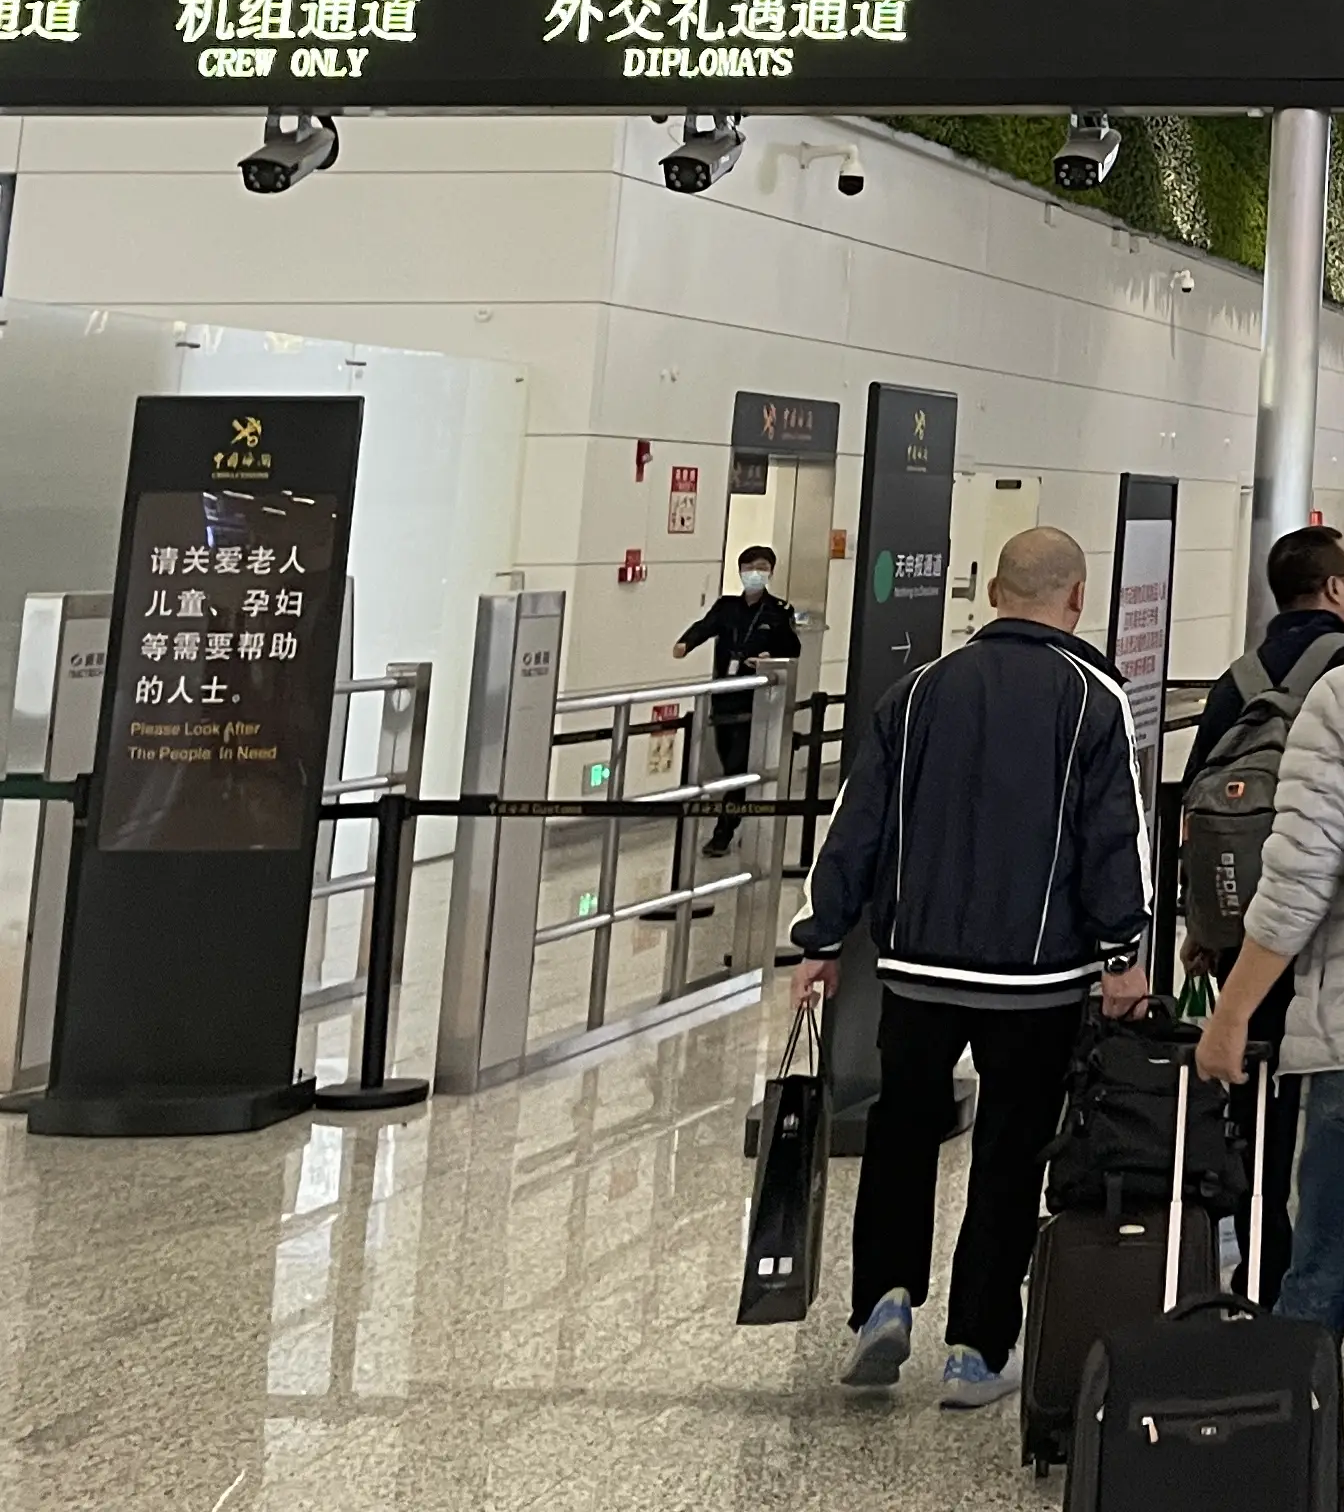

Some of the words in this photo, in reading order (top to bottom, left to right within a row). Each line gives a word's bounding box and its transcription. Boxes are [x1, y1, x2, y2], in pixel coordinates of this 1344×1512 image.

[198, 47, 278, 78] CREW
[290, 47, 369, 78] ONLY
[622, 47, 794, 79] DIPLOMATS
[151, 546, 305, 575] 请关爱老人
[141, 632, 297, 662] 等需要帮助
[135, 675, 240, 705] 的人士。
[130, 722, 181, 736] Please
[184, 722, 220, 736] Look
[224, 722, 261, 736] After
[128, 746, 156, 760] The
[158, 746, 212, 763] People
[219, 746, 233, 760] In
[236, 746, 277, 761] Need
